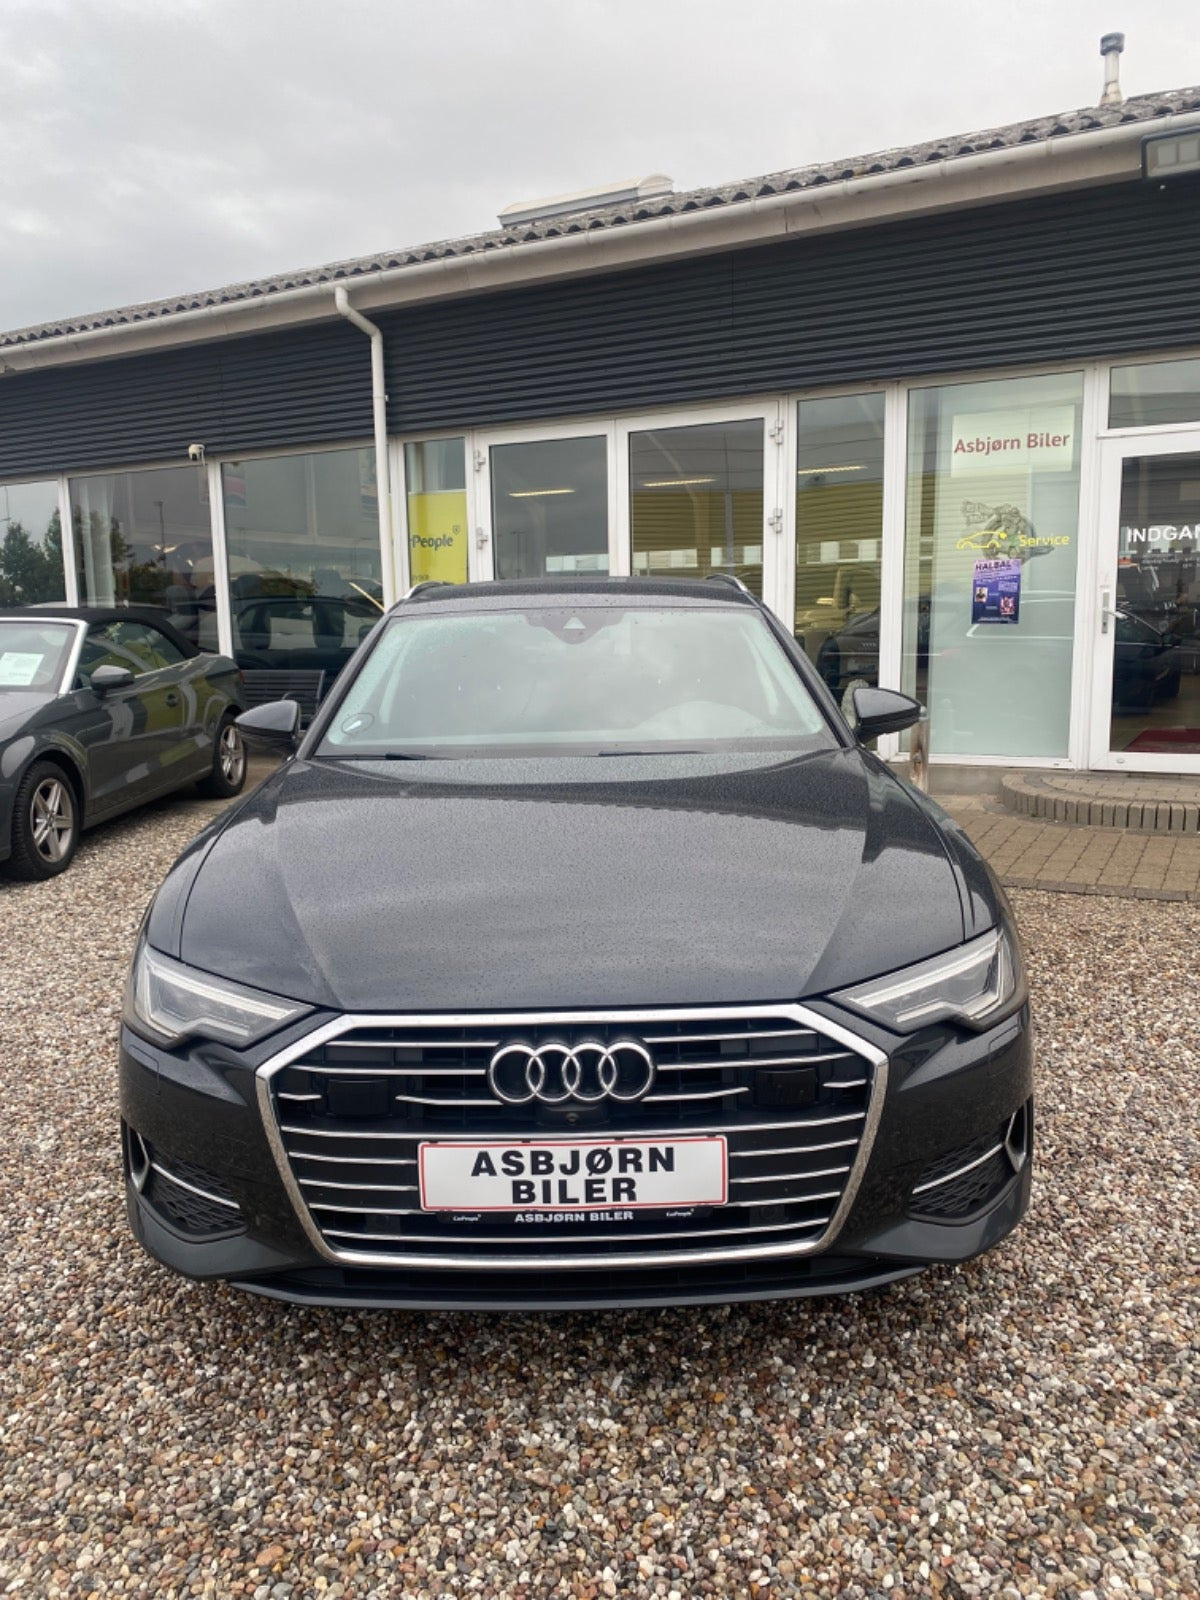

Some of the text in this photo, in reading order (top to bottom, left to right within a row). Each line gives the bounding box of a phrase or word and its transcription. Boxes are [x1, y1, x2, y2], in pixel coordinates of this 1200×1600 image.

[954, 433, 1071, 456] Asbjørn Biler
[410, 533, 453, 551] People
[1018, 533, 1070, 547] Service
[471, 1146, 675, 1177] ASBJØRN
[512, 1178, 637, 1204] BILER
[514, 1210, 634, 1223] ASBJØRN BILER
